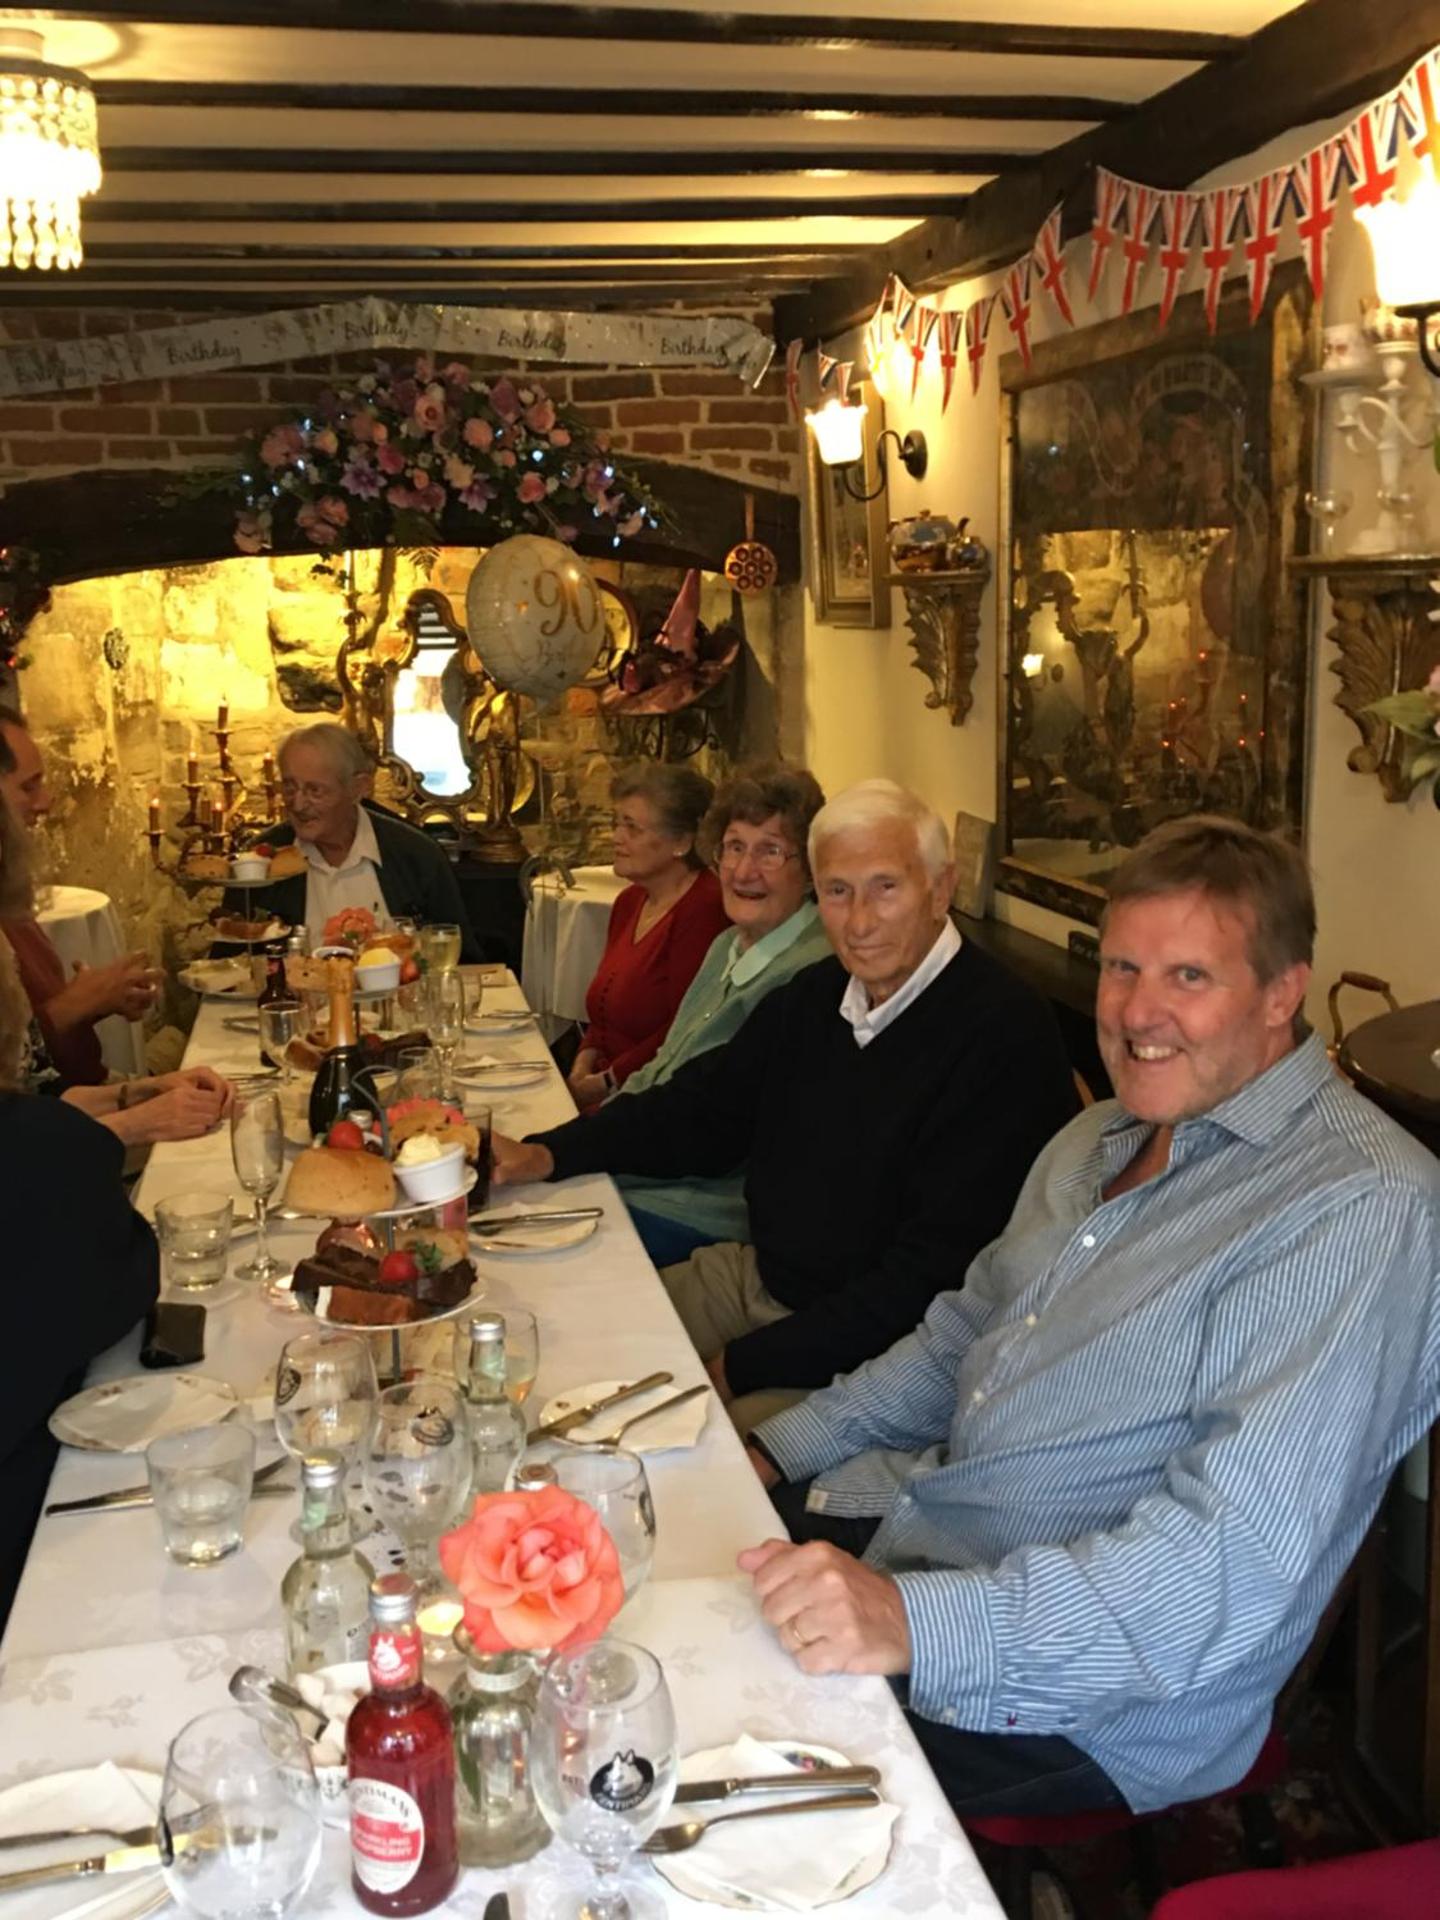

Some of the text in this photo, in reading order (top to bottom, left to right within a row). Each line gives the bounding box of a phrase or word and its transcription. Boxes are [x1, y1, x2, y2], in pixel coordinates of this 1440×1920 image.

[15, 356, 86, 387] Birtay
[167, 338, 241, 365] Birthday
[533, 569, 598, 636] 90
